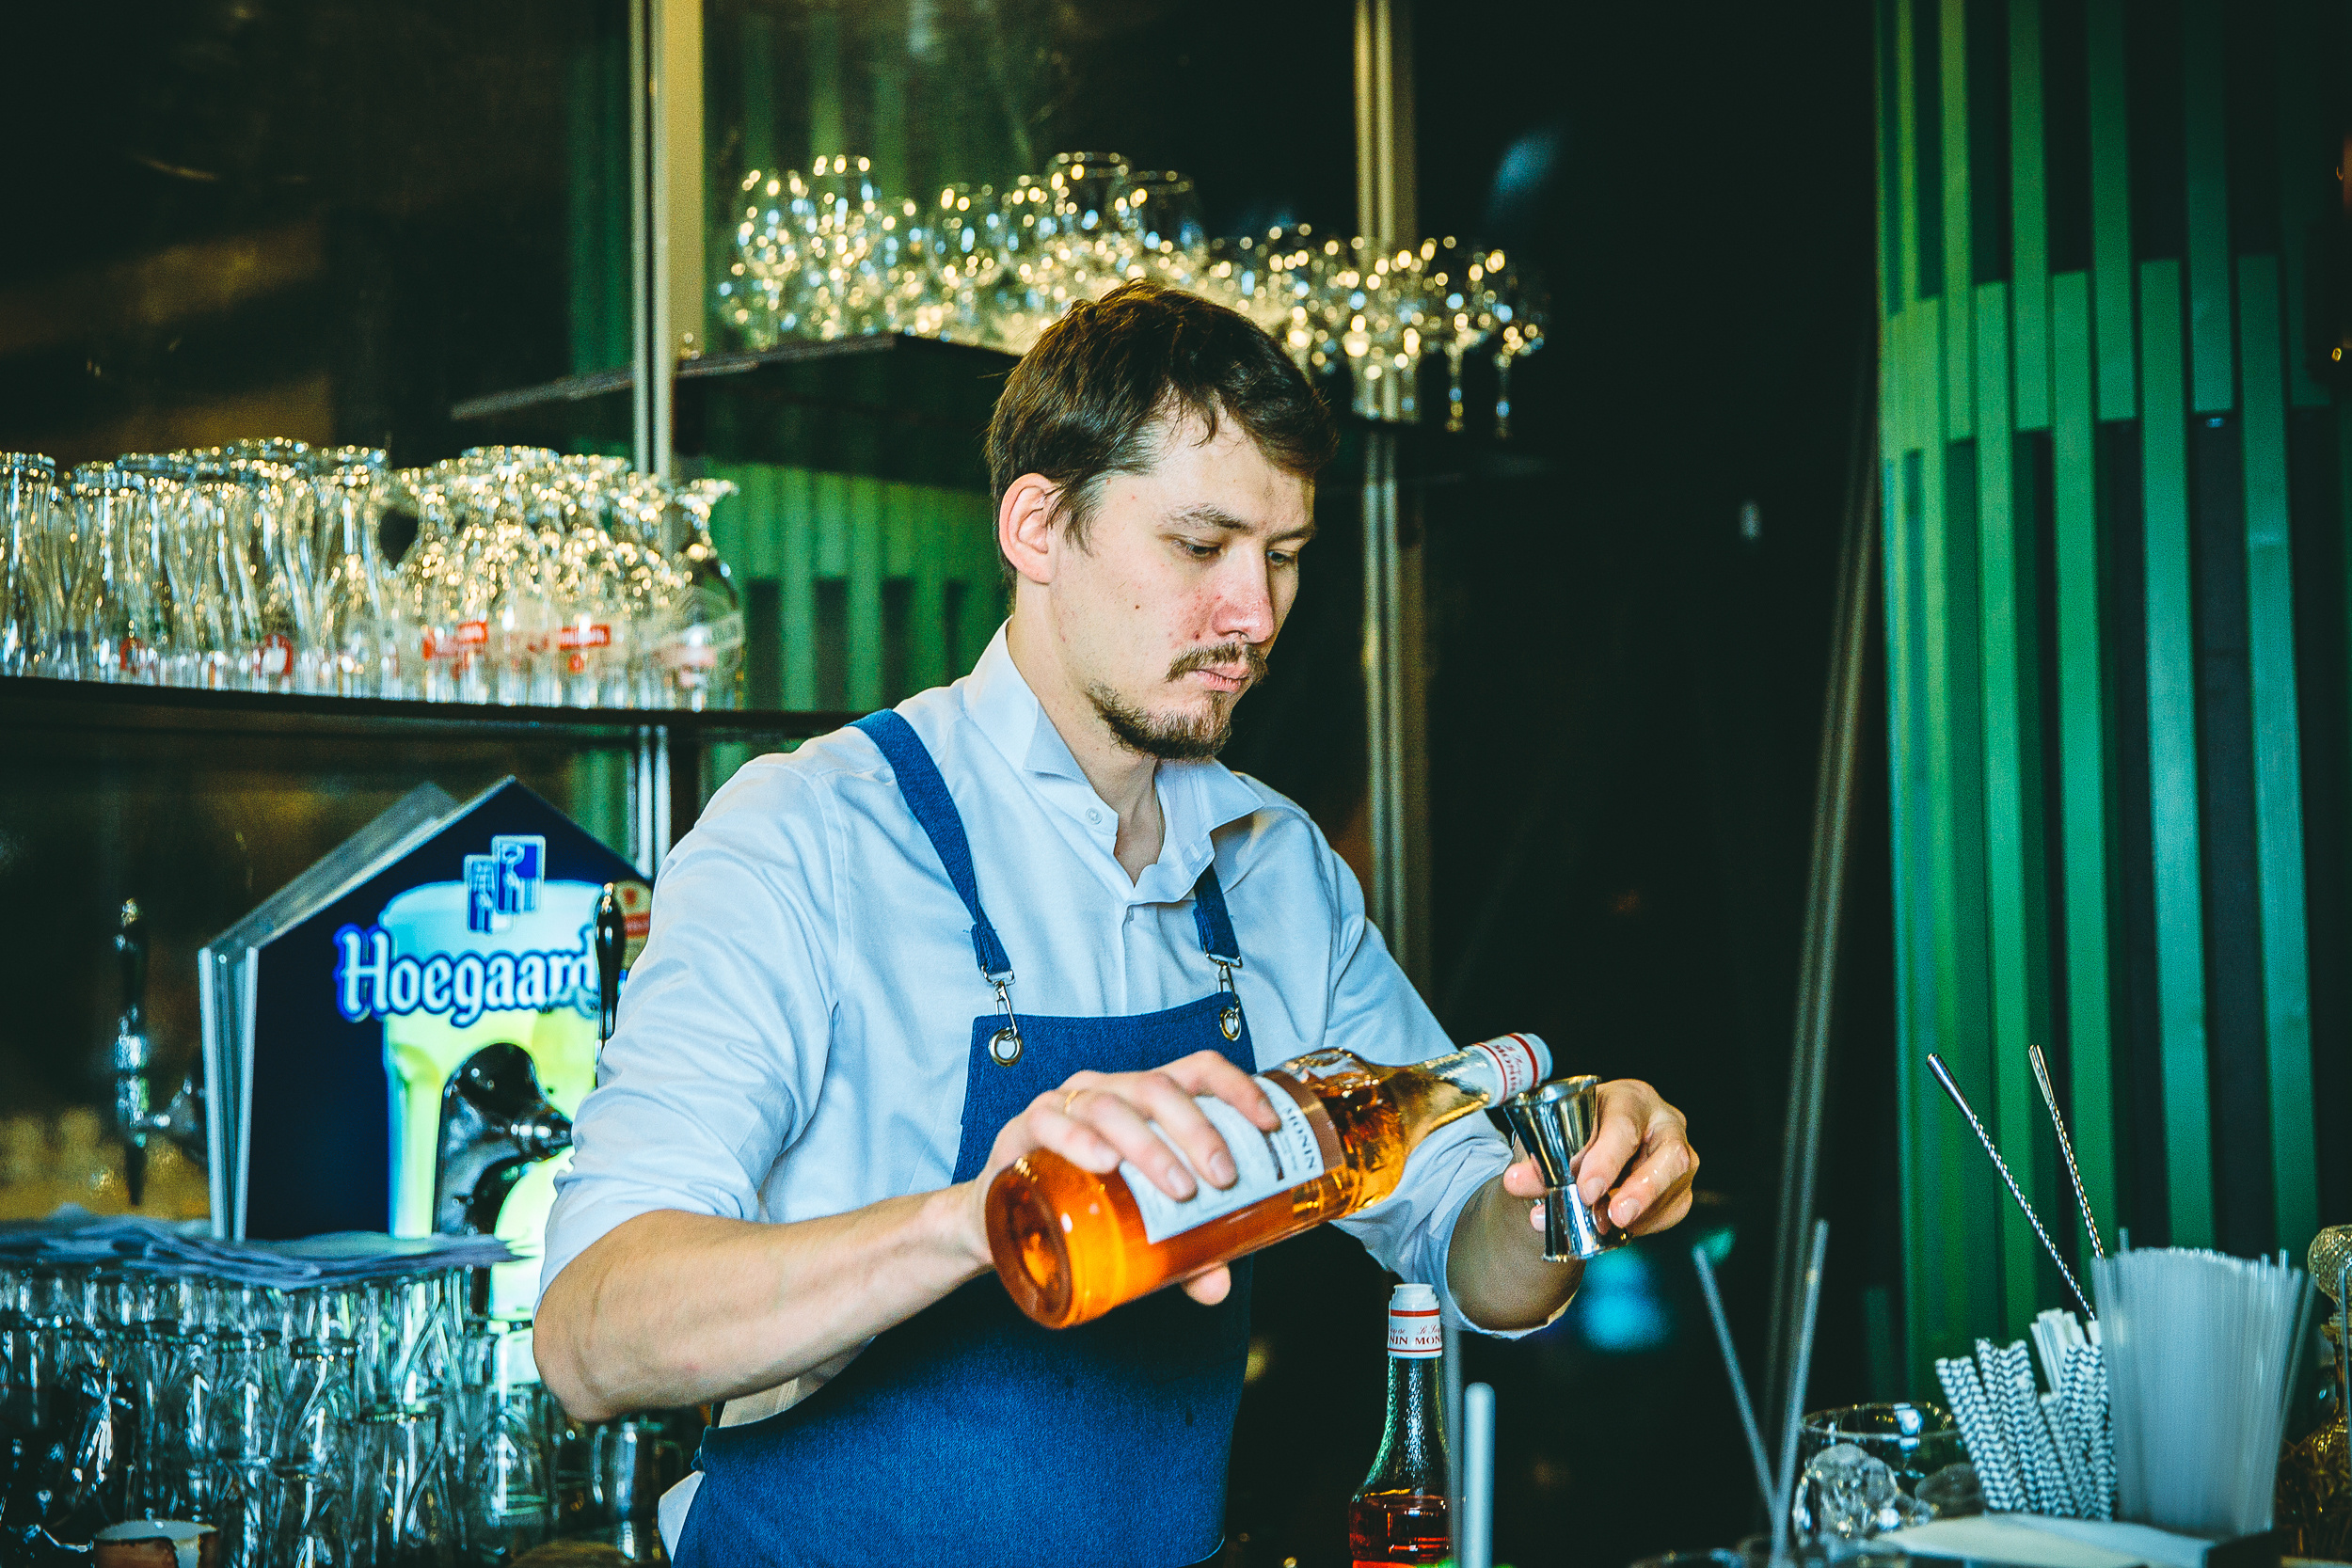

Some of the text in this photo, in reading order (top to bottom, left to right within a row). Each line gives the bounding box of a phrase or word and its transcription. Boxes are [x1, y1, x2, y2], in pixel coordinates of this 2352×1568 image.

[337, 925, 602, 1026] Hoegaard
[1284, 1106, 1316, 1170] MONIN
[1390, 1334, 1440, 1345] NIN MON
